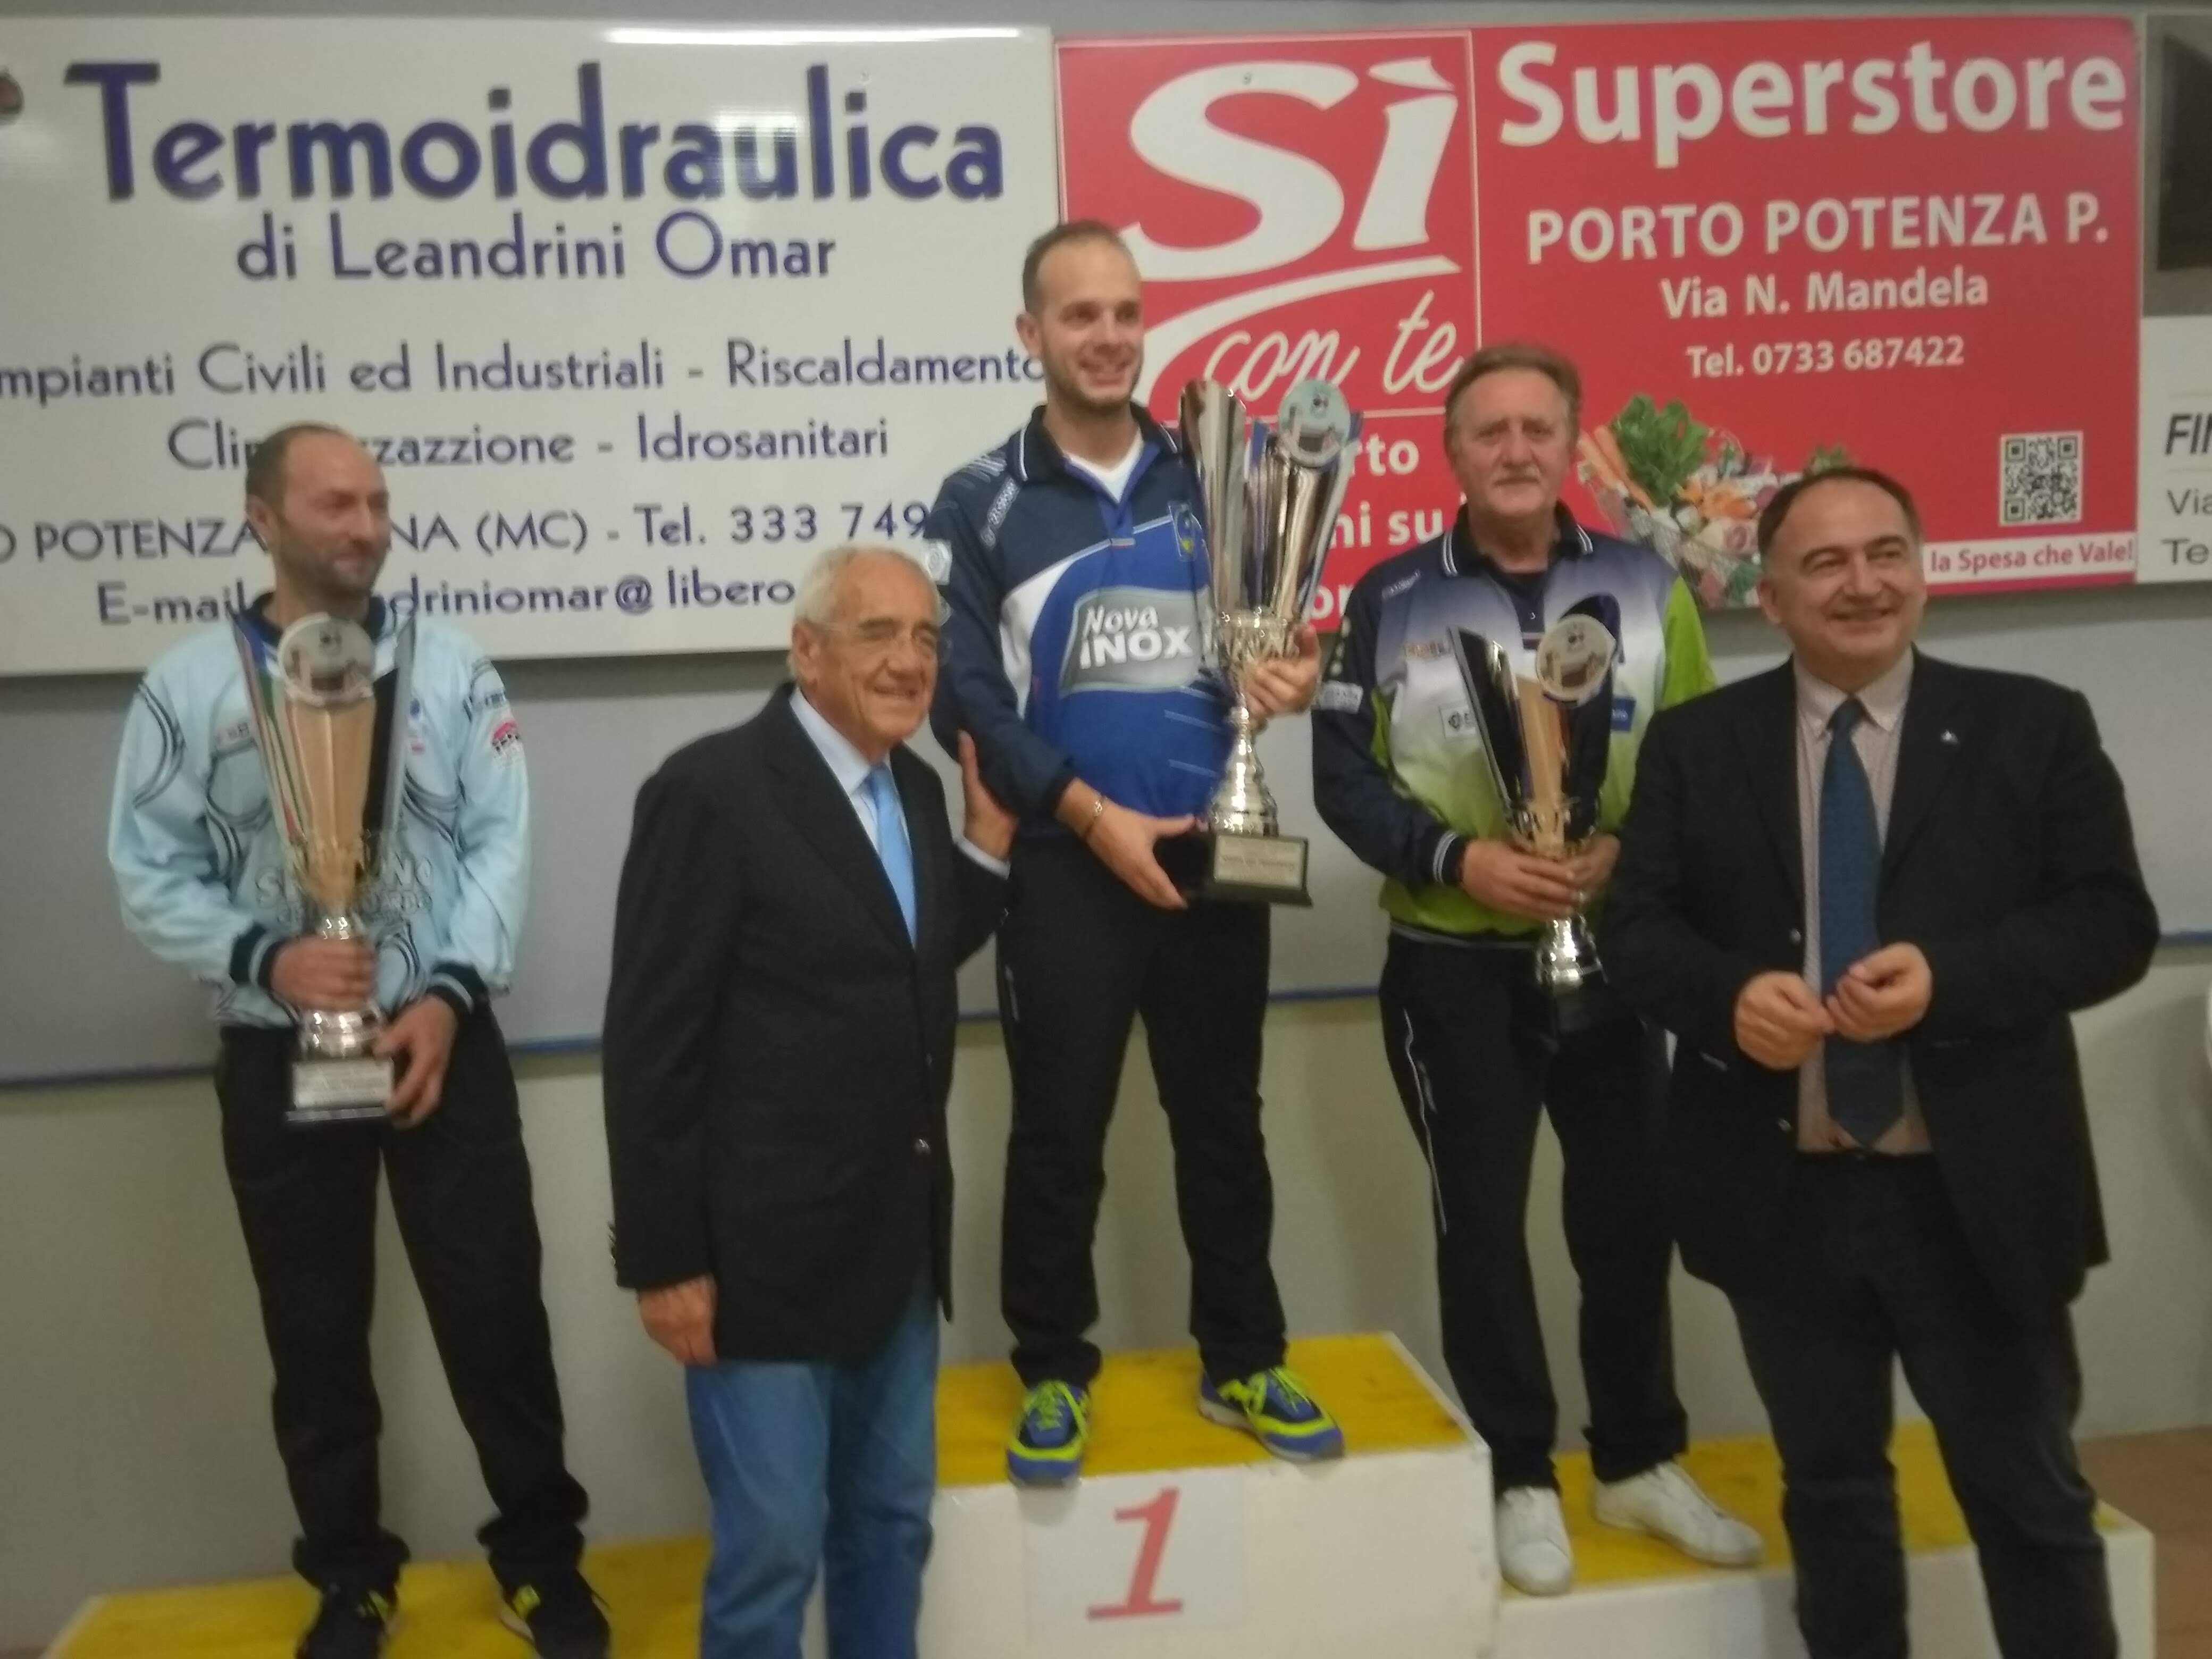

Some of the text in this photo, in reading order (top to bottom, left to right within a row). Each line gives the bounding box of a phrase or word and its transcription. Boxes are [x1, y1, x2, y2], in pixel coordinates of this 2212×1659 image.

[63, 61, 1003, 203] Termoidraulica
[1498, 41, 2125, 169] Superstore
[237, 210, 836, 280] di Leandrini Omar
[1528, 192, 2108, 265] PORTO POTENZA P.
[1660, 265, 1988, 319] Via N. Mandela
[198, 341, 326, 393] Civili
[350, 342, 411, 391] ed
[435, 340, 663, 391] Industriali
[727, 337, 1043, 387] Riscaldamento
[1203, 289, 1464, 401] con te
[1686, 335, 1964, 378] Tel. 0733 687422
[638, 413, 887, 460] Idrosanitari
[1388, 508, 1443, 546] su
[2166, 489, 2212, 516] Via
[35, 516, 270, 562] POTENZA
[476, 511, 587, 555] (MC)
[634, 503, 705, 545] Tel.
[731, 505, 817, 542] 333
[1931, 539, 2133, 575] la Spesa che Vale!
[1079, 626, 1194, 669] INOX
[1086, 1488, 1183, 1621] 1
